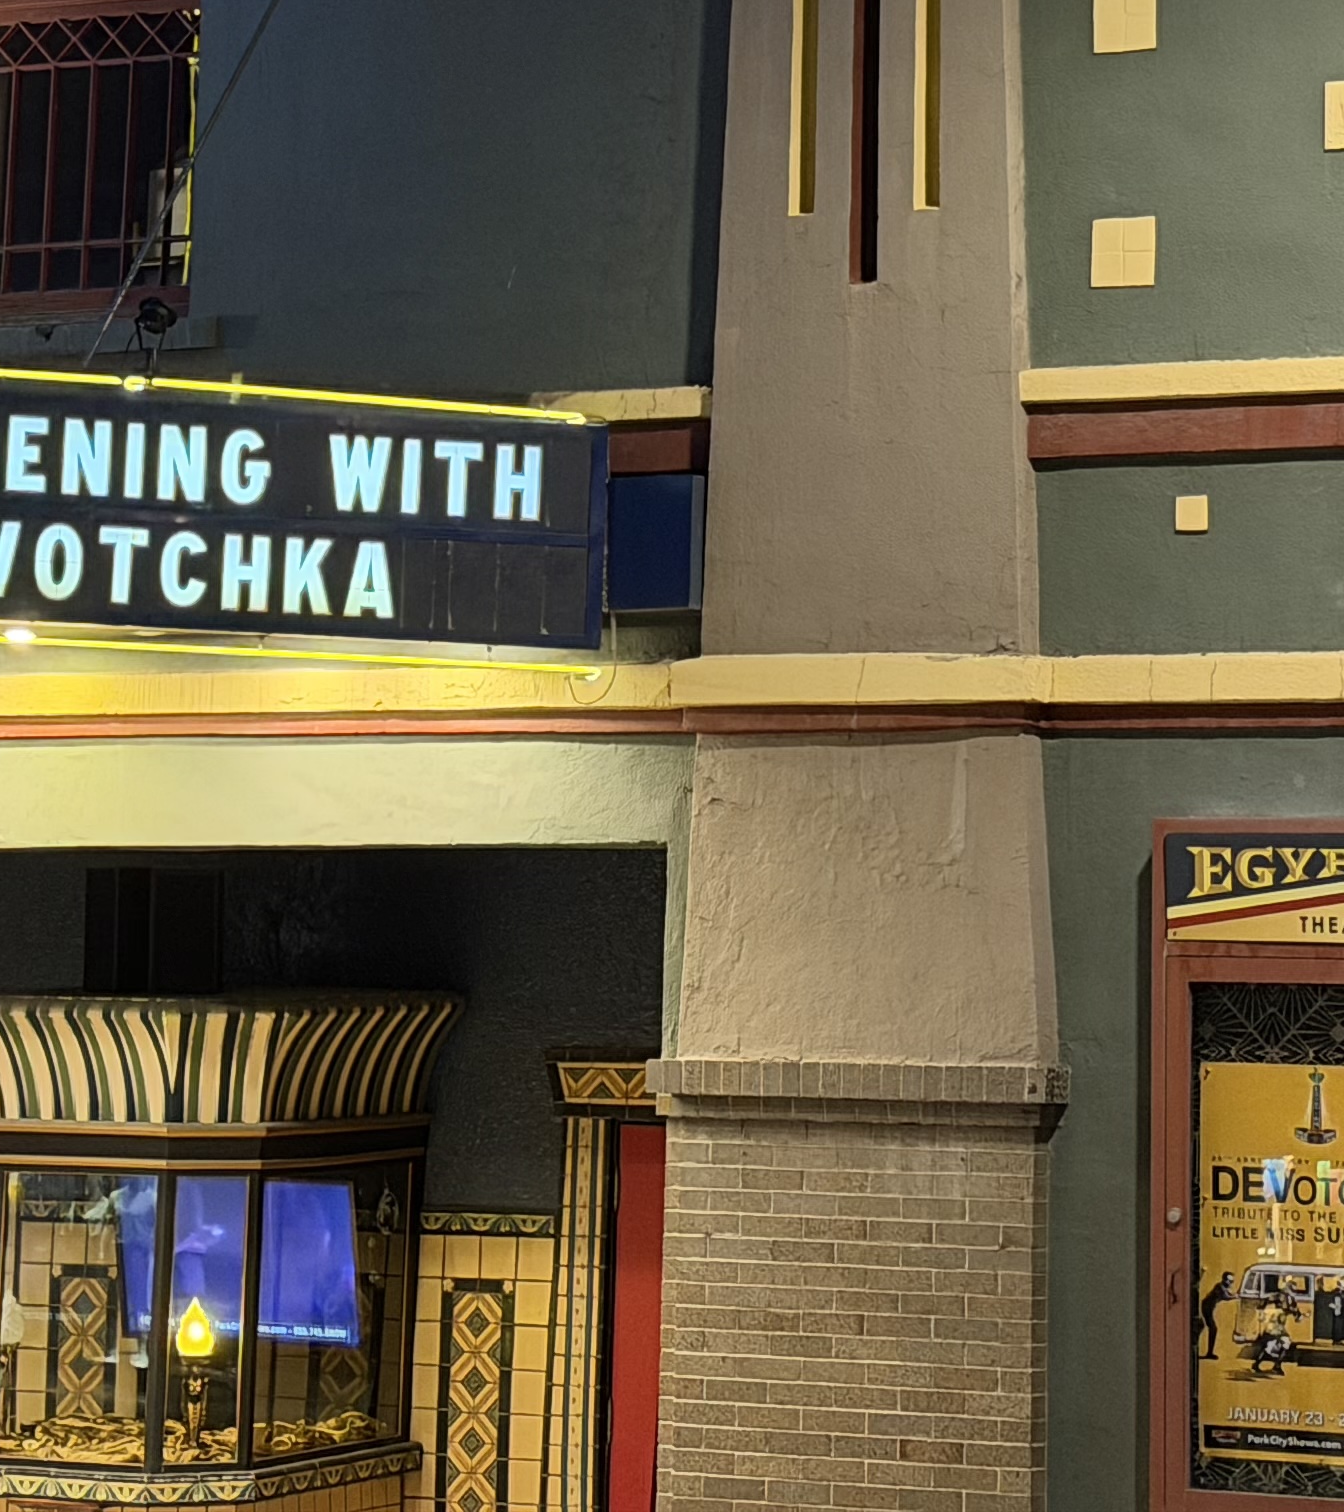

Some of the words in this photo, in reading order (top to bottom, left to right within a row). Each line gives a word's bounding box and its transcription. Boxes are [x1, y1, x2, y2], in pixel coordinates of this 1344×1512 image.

[329, 433, 543, 522] WITH
[1212, 1206, 1273, 1221] TRIBUTE
[1282, 1209, 1301, 1222] TO
[1307, 1210, 1337, 1224] THE
[1212, 1226, 1259, 1239] LITTLE
[1226, 1406, 1302, 1425] JANUARY
[1304, 1411, 1323, 1426] 23
